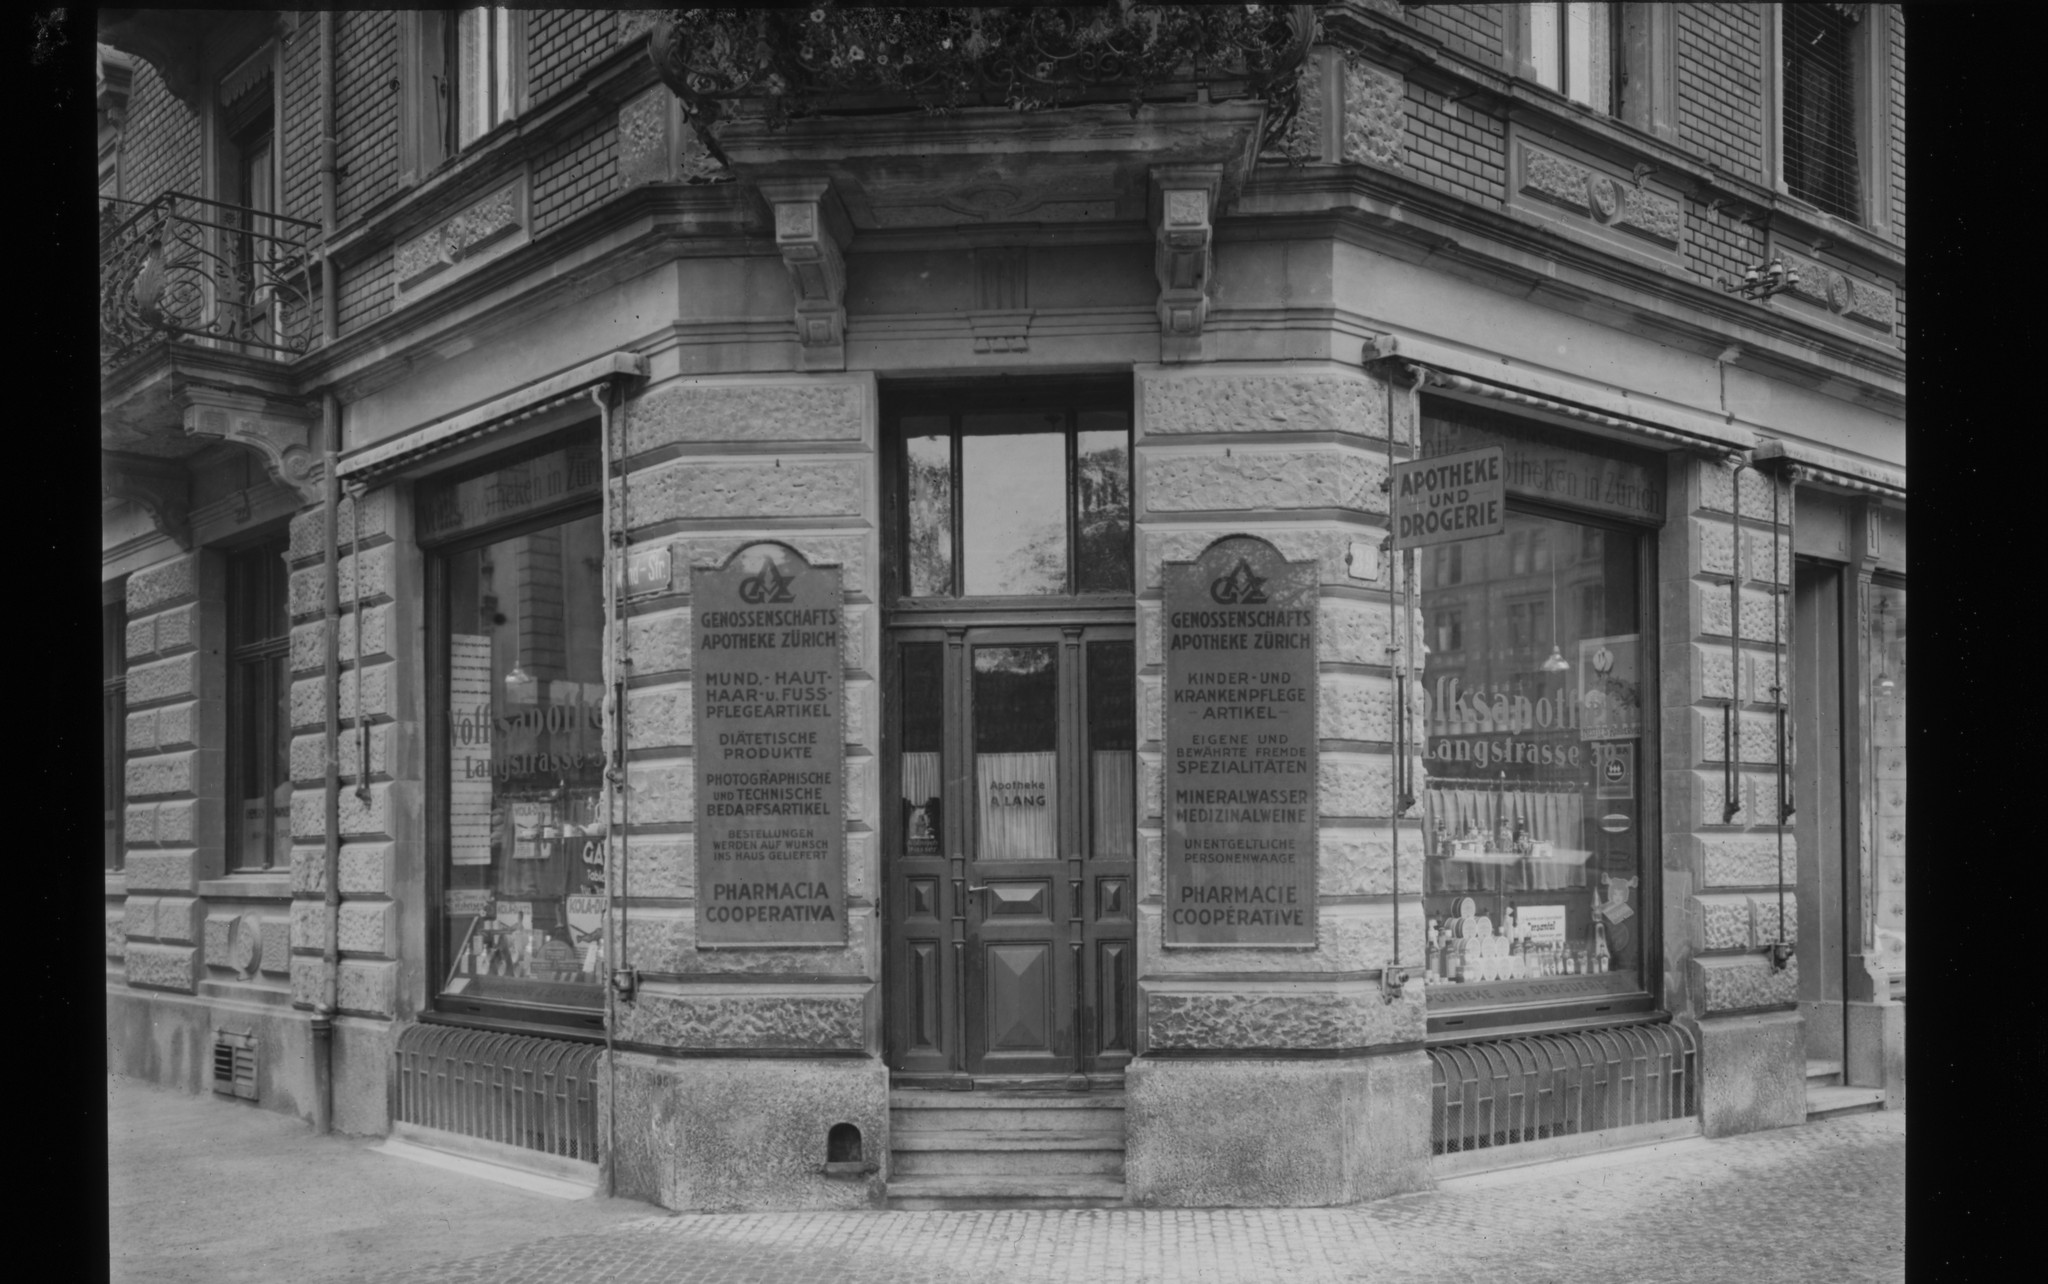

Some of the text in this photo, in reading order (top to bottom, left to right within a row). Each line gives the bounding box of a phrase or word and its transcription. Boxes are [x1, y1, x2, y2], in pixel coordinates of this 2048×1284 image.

[548, 463, 563, 497] in
[1400, 456, 1499, 498] APOTHEKE
[1429, 488, 1470, 508] UND
[1584, 467, 1600, 502] in
[1605, 470, 1661, 514] Zürich
[1400, 500, 1498, 539] DROGERIE
[701, 609, 837, 628] GENOSSENSCHAFTS
[1171, 610, 1312, 628] GENOSSENSCHAFTS
[701, 630, 837, 650] APOTHEKE ZÜRICH
[1171, 631, 1310, 650] APOTHEKE ZÜRICH
[775, 671, 832, 685] HAUT-
[1174, 688, 1306, 702] KRANKENPFLEGE
[706, 704, 832, 718] PFLEGEARTIKEL
[719, 730, 818, 745] DIÄTETISCHE
[1192, 734, 1289, 745] EIGENE UND
[723, 746, 812, 759] PRODUKTE
[1176, 746, 1307, 758] BEWÄHRTE FREMDE
[1422, 736, 1580, 768] Langstrasse
[465, 750, 584, 782] Langstrasse
[1176, 759, 1307, 774] SPEZIALITÄTEN
[706, 772, 832, 786] PHOTOGRAPHISCHE
[990, 780, 1046, 791] Apotheke
[713, 787, 822, 801] UND TECHNISCHE
[1005, 795, 1046, 807] LANG
[1176, 789, 1308, 804] MINERALWASSER
[706, 803, 831, 816] BEDARFSARTIKEL
[1176, 808, 1307, 823] MEDIZINALWEINE
[728, 829, 814, 839] BESTELLUNGEN
[713, 840, 828, 850] WERDEN AUF WUNSCH
[1184, 838, 1296, 850] UNENTGELTLICHE
[583, 840, 604, 866] GA
[713, 850, 828, 861] INS HAUS GELIEFERT
[1184, 853, 1296, 864] PERSONENWAAGE
[714, 881, 829, 900] PHARMACIA
[1181, 885, 1297, 903] PHARMACIE
[706, 905, 836, 922] COOPERATIVA
[1172, 905, 1304, 926] COOPÉRATIVE
[1501, 988, 1525, 999] UND
